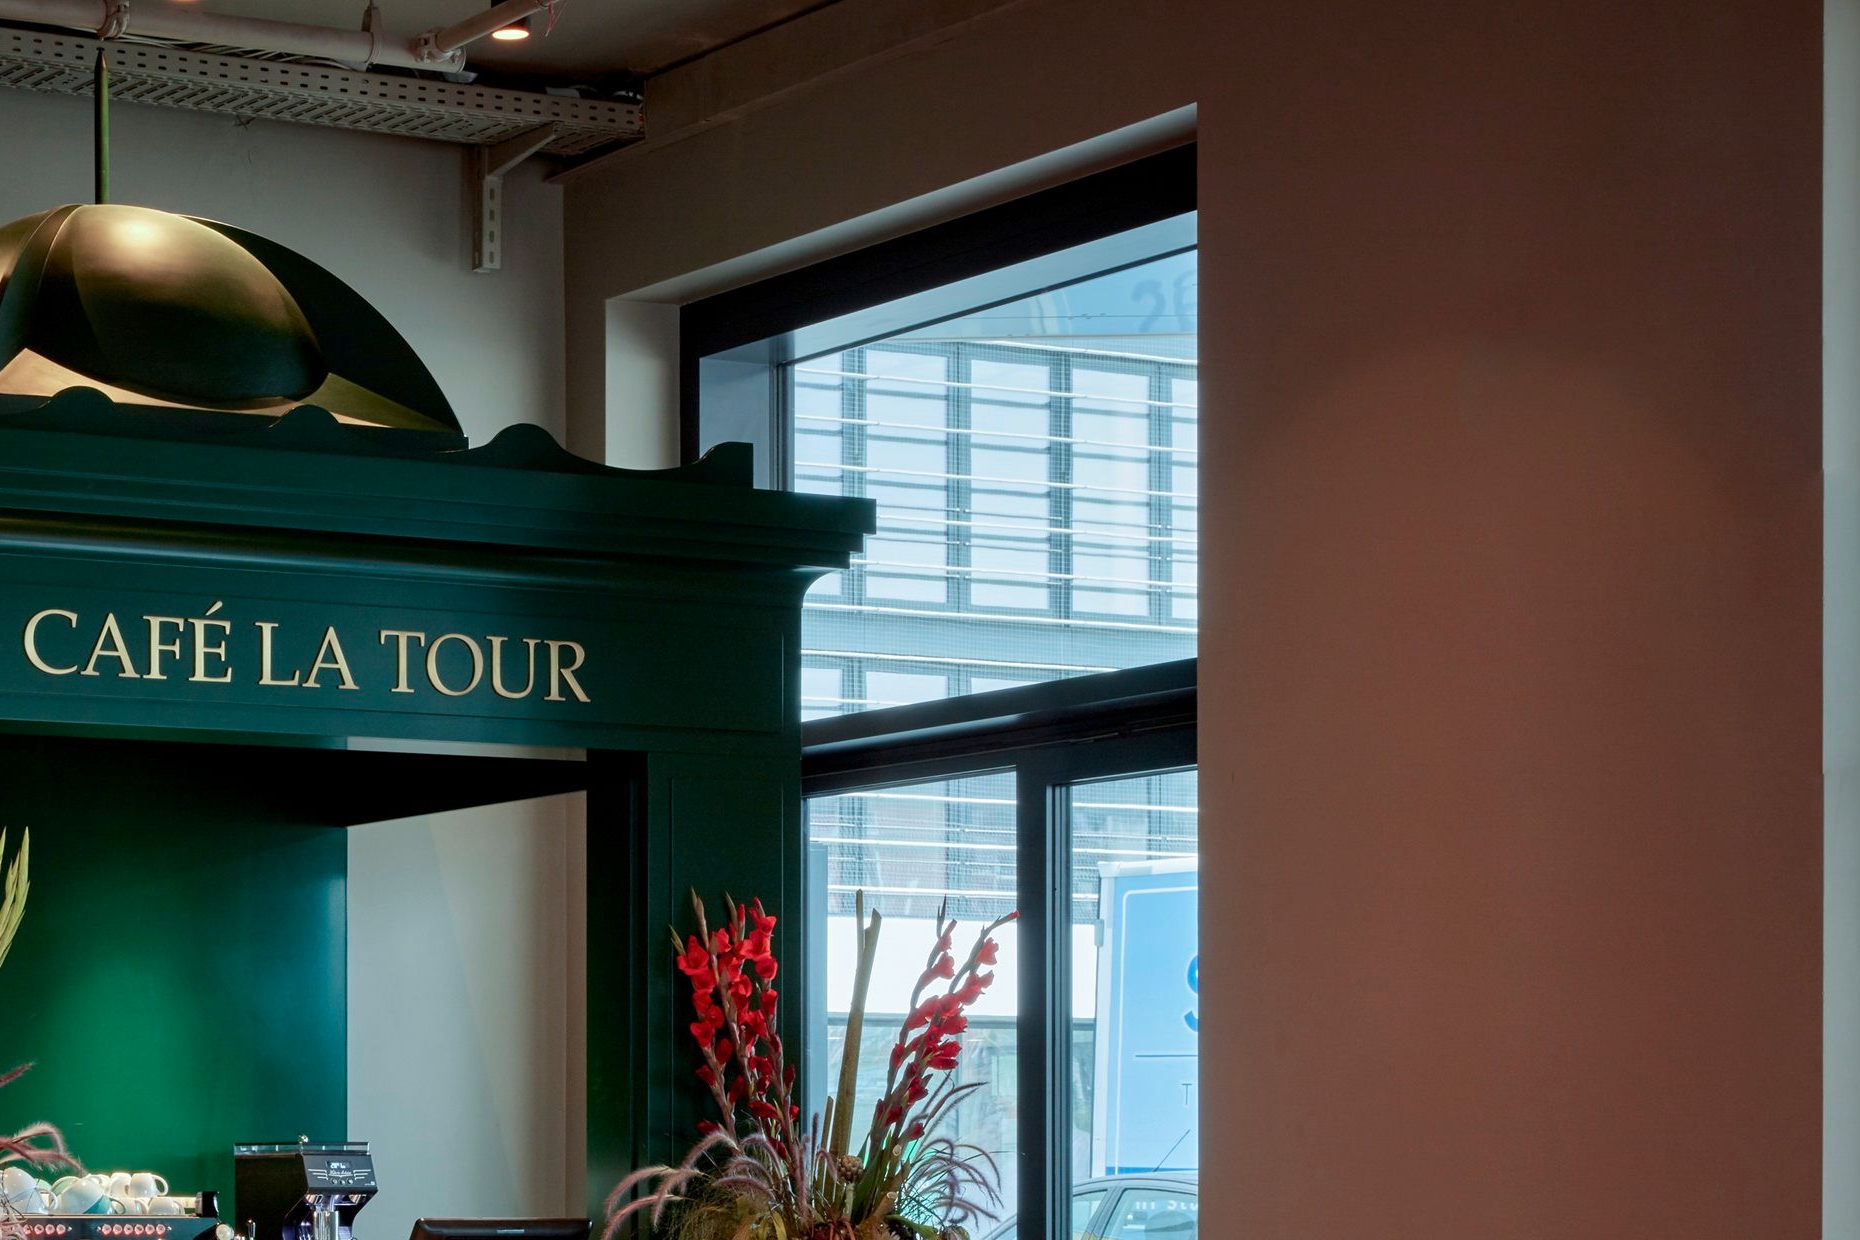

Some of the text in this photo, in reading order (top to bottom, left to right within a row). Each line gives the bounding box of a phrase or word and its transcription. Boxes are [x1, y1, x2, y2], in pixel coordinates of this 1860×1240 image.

[24, 600, 592, 703] CAFÉ LA TOUR
